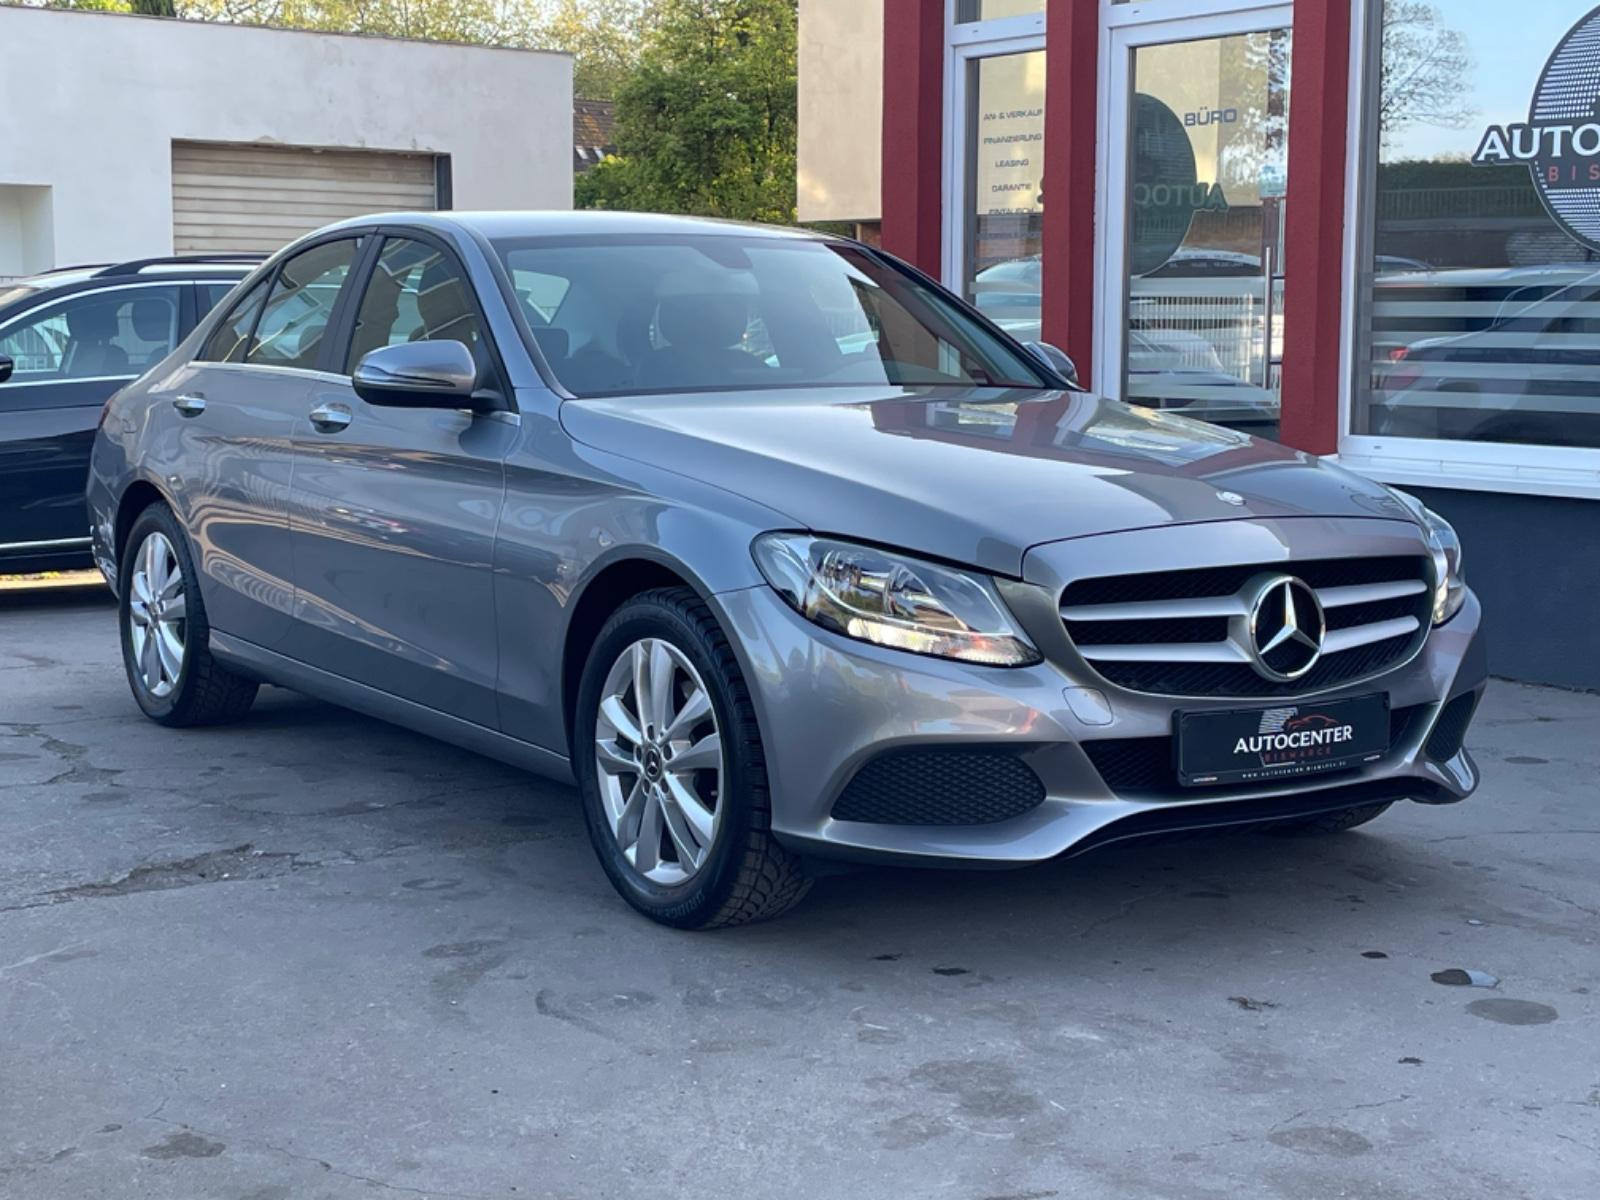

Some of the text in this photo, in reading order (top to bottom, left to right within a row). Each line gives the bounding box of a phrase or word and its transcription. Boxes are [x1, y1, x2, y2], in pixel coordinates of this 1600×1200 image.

[1007, 108, 1043, 118] VERKAUF
[1184, 106, 1237, 126] BÜRO
[984, 133, 1042, 144] FINANZIERUNG
[1477, 123, 1600, 161] AUTO
[995, 159, 1029, 168] LEASING
[1548, 164, 1600, 182] BIS
[1233, 725, 1353, 754] AUTOCENTER
